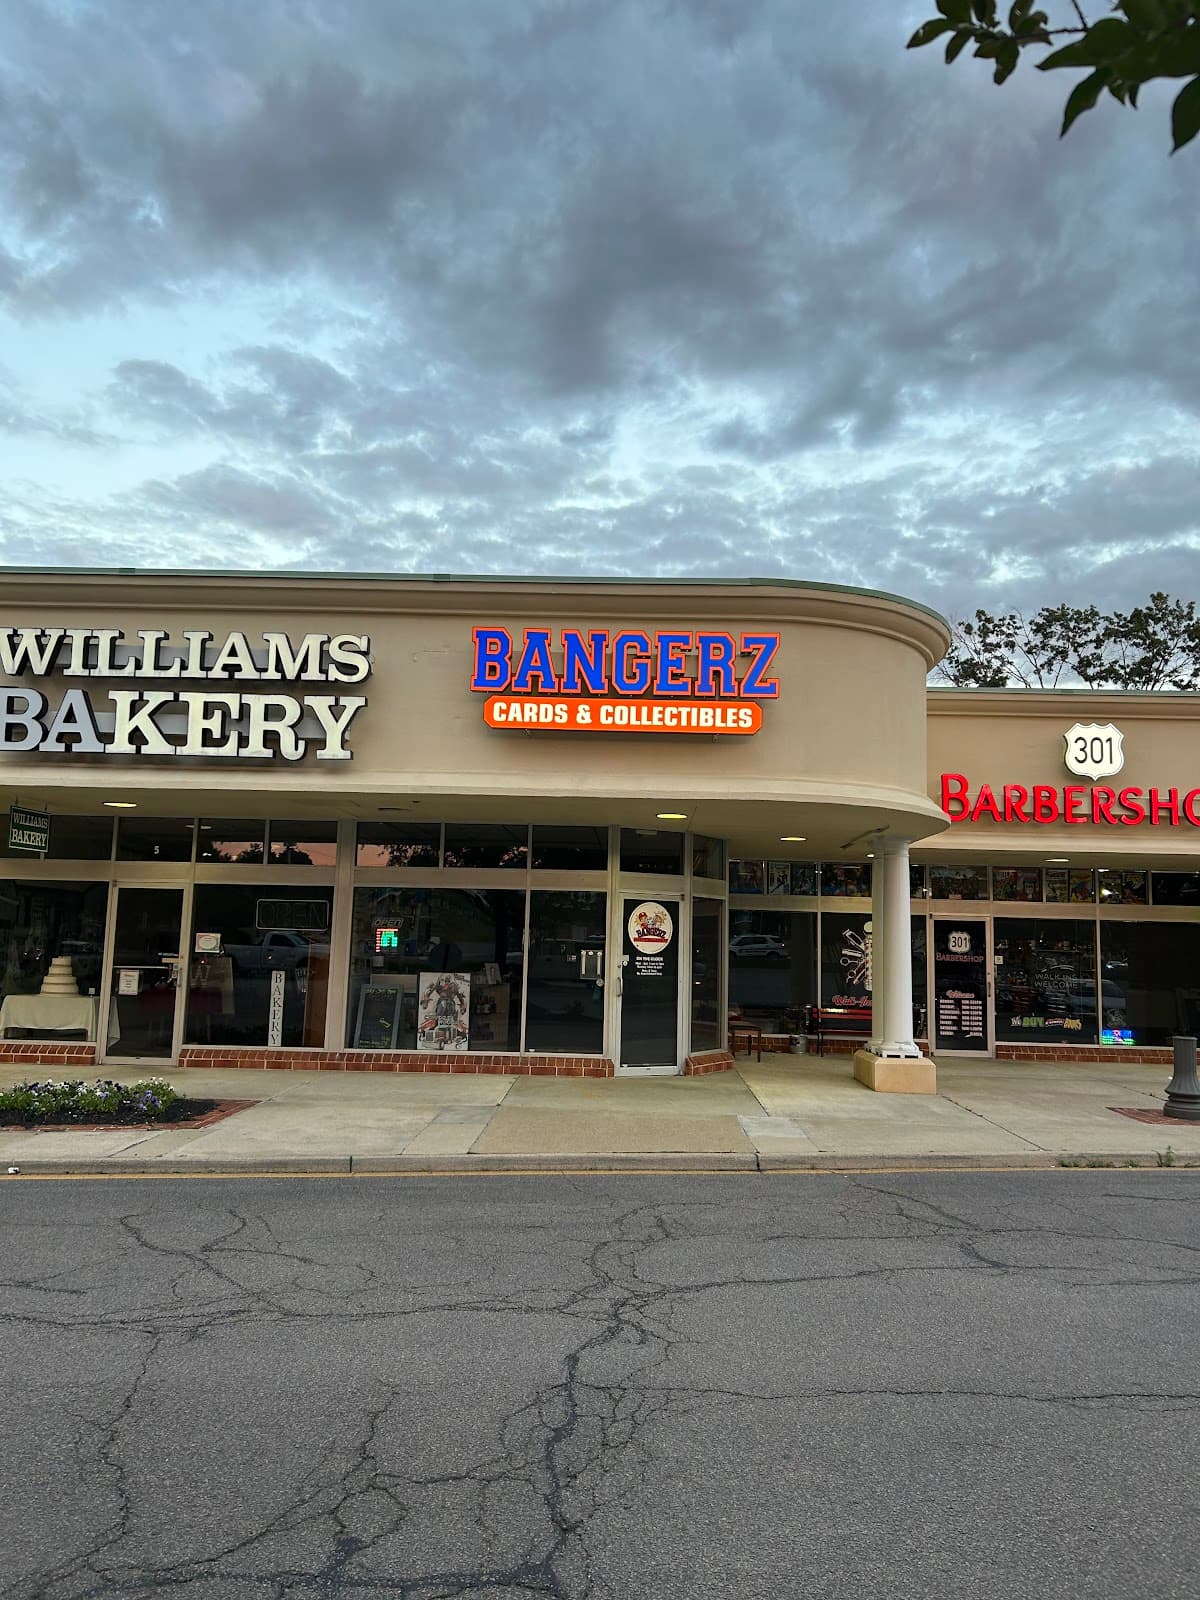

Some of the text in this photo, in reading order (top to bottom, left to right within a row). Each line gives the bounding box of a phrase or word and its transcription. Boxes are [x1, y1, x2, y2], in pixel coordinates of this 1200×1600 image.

[0, 628, 371, 683] WILLIAMS
[470, 626, 780, 698] BANGERZ
[0, 686, 367, 761] BAKERY
[492, 701, 753, 729] CARDS & COLLECTIBLES
[1073, 736, 1114, 765] 301
[13, 812, 48, 829] WILLIAMS
[11, 828, 47, 847] BAKERY
[153, 845, 160, 855] 5
[951, 936, 968, 948] 301
[936, 952, 984, 963] BARBERSHOP
[271, 972, 283, 1045] BAKERY
